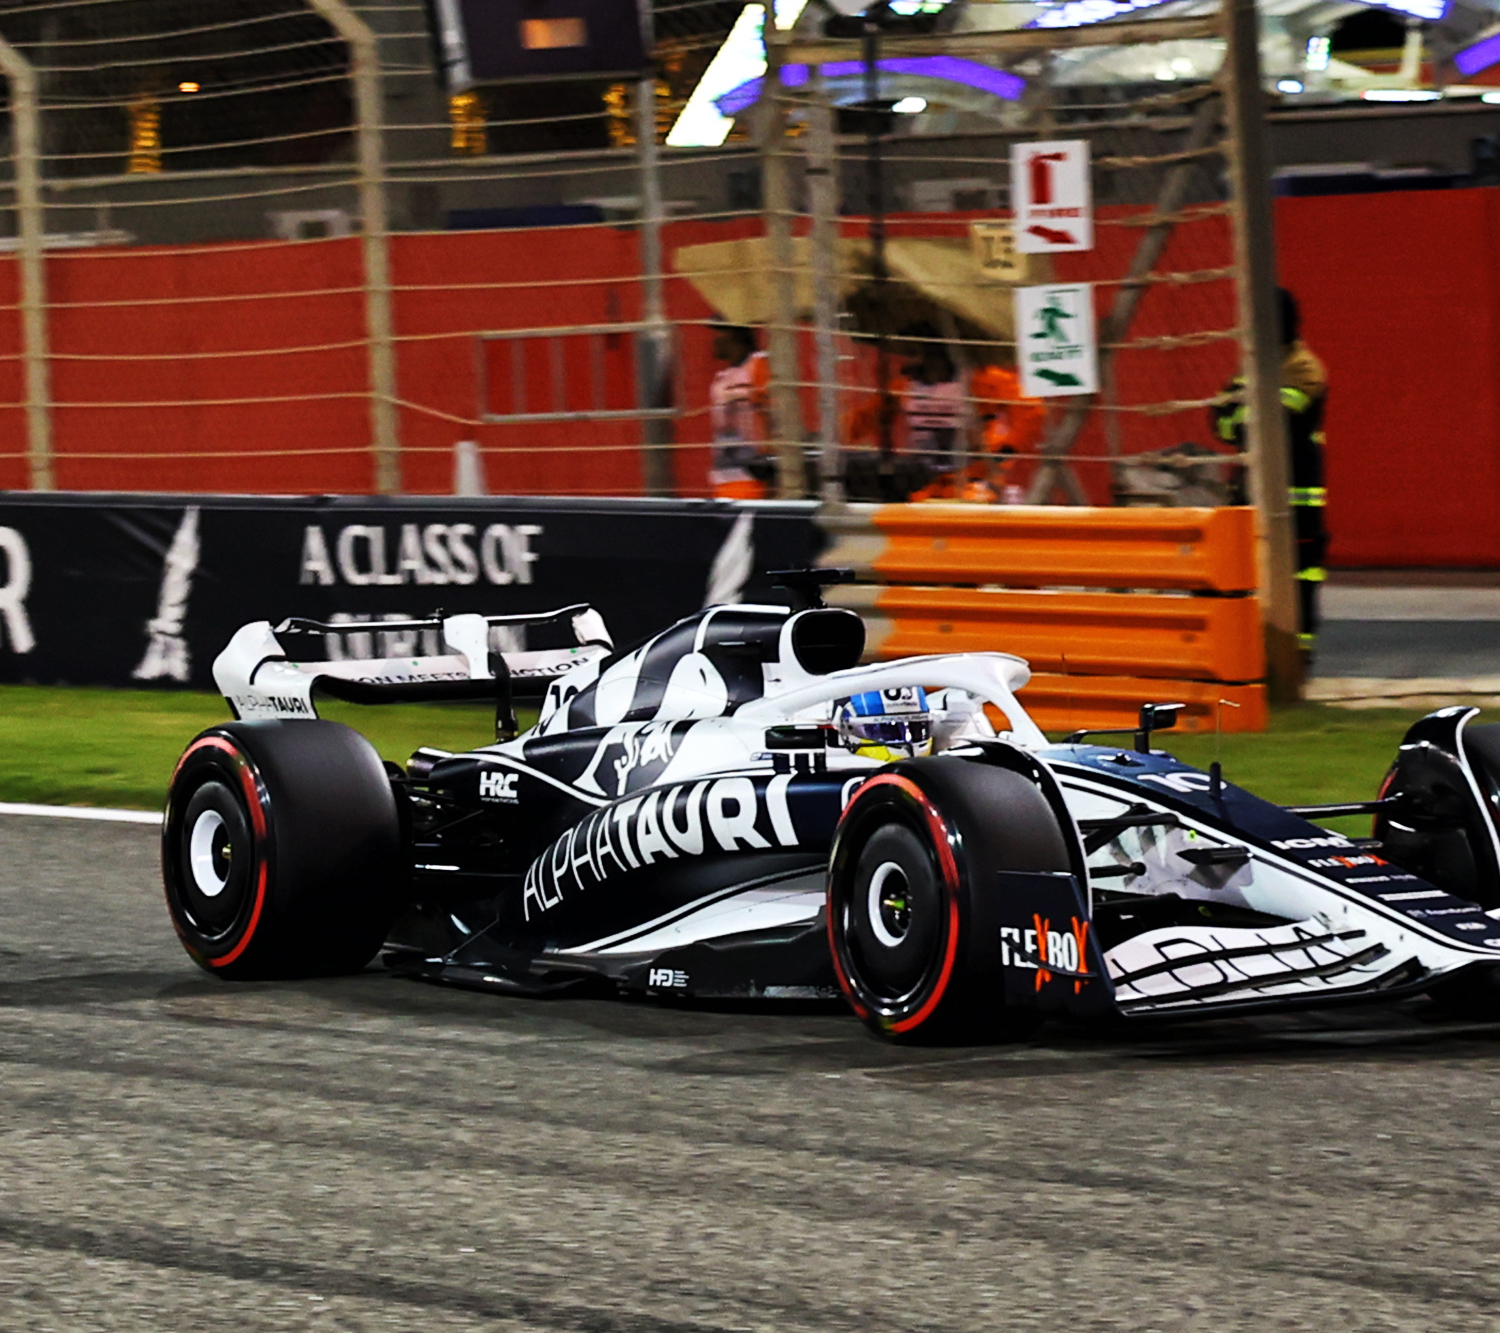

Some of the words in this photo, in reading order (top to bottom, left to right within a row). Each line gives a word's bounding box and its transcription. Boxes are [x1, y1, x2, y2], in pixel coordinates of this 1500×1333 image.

[299, 525, 335, 585] A
[337, 523, 480, 586] CLASS
[481, 523, 544, 586] OF
[523, 777, 799, 922] ALPHATAURI
[1000, 913, 1089, 994] FLEXBOX
